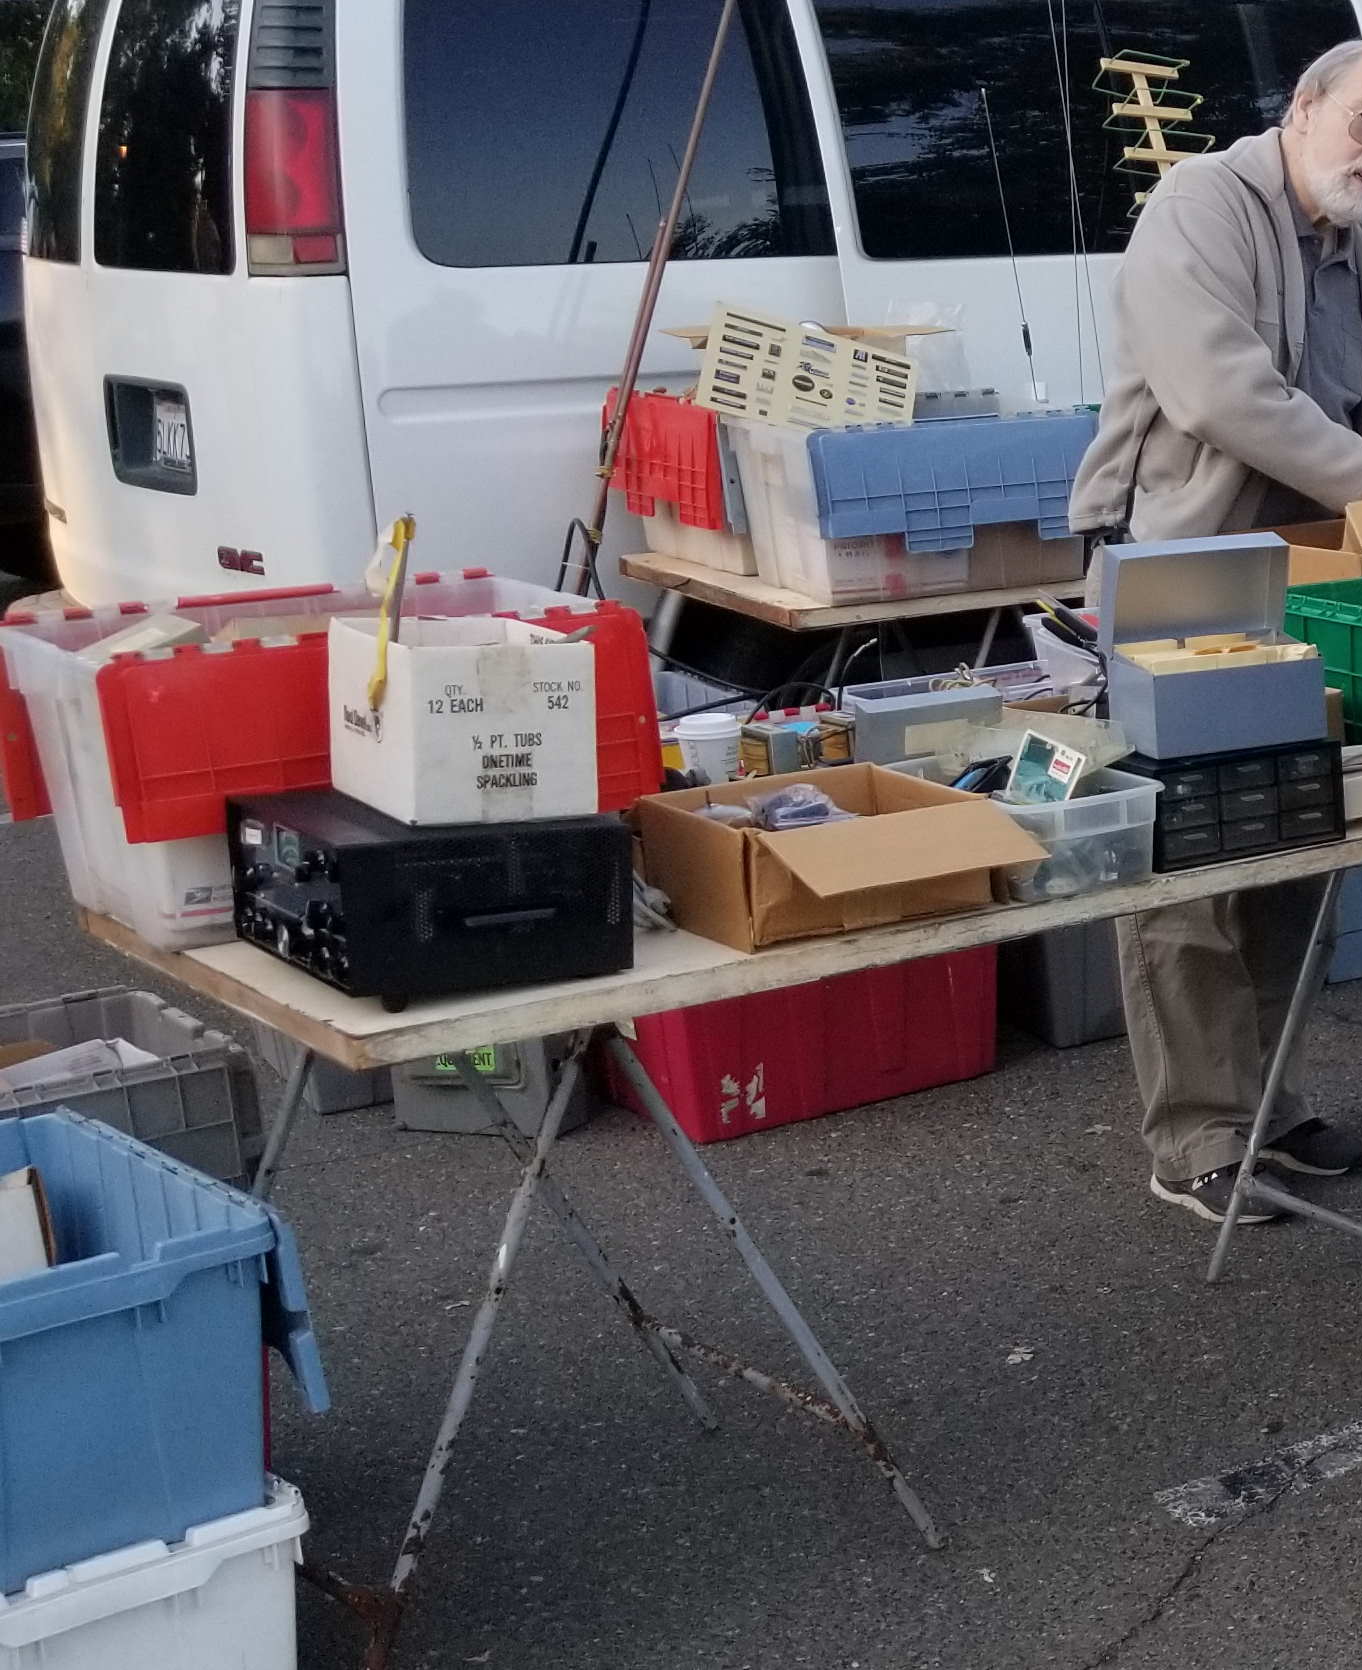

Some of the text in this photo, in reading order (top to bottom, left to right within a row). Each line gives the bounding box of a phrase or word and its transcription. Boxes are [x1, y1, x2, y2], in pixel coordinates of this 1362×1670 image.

[533, 681, 563, 692] STOCK
[428, 697, 484, 714] 12 EACH
[547, 695, 569, 710] 542
[490, 734, 508, 749] PT.
[513, 732, 542, 748] TUBS
[482, 753, 533, 769] ONETIME
[477, 772, 538, 790] SPACKLING
